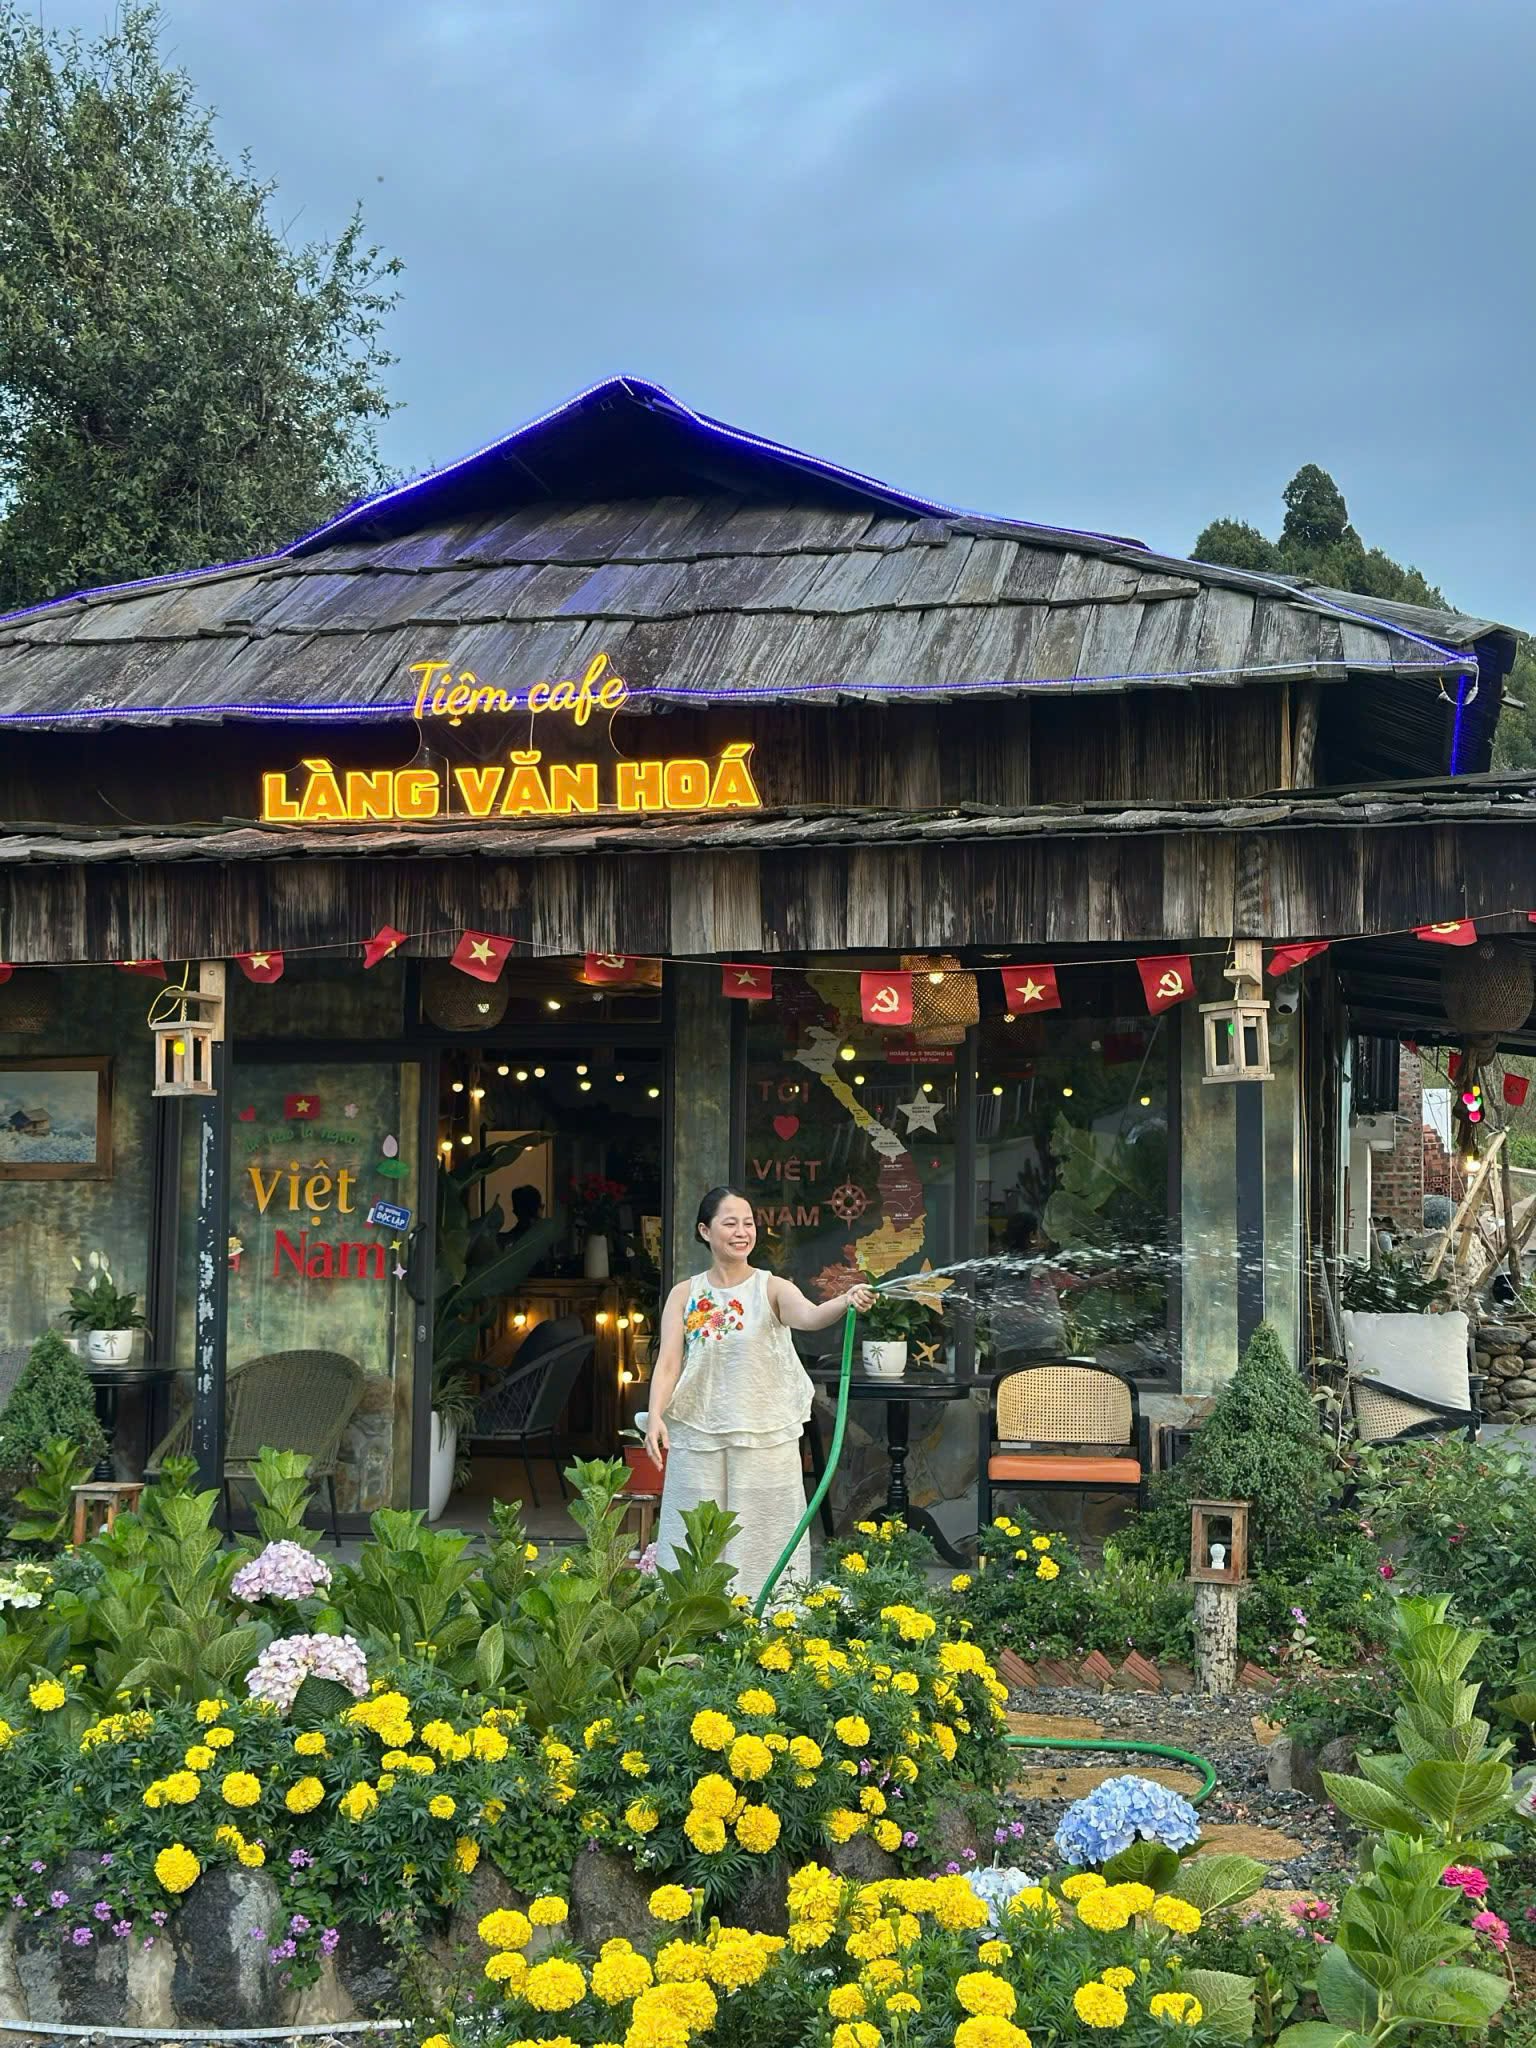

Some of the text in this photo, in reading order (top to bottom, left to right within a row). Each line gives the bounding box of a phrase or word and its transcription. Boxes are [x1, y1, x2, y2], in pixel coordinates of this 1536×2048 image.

[409, 653, 627, 726] Tiệm cafe
[262, 743, 760, 822] LÀNG VĂN HOÁ
[247, 1159, 356, 1227] Việt
[754, 1205, 821, 1227] NAM
[273, 1229, 386, 1280] Nam
